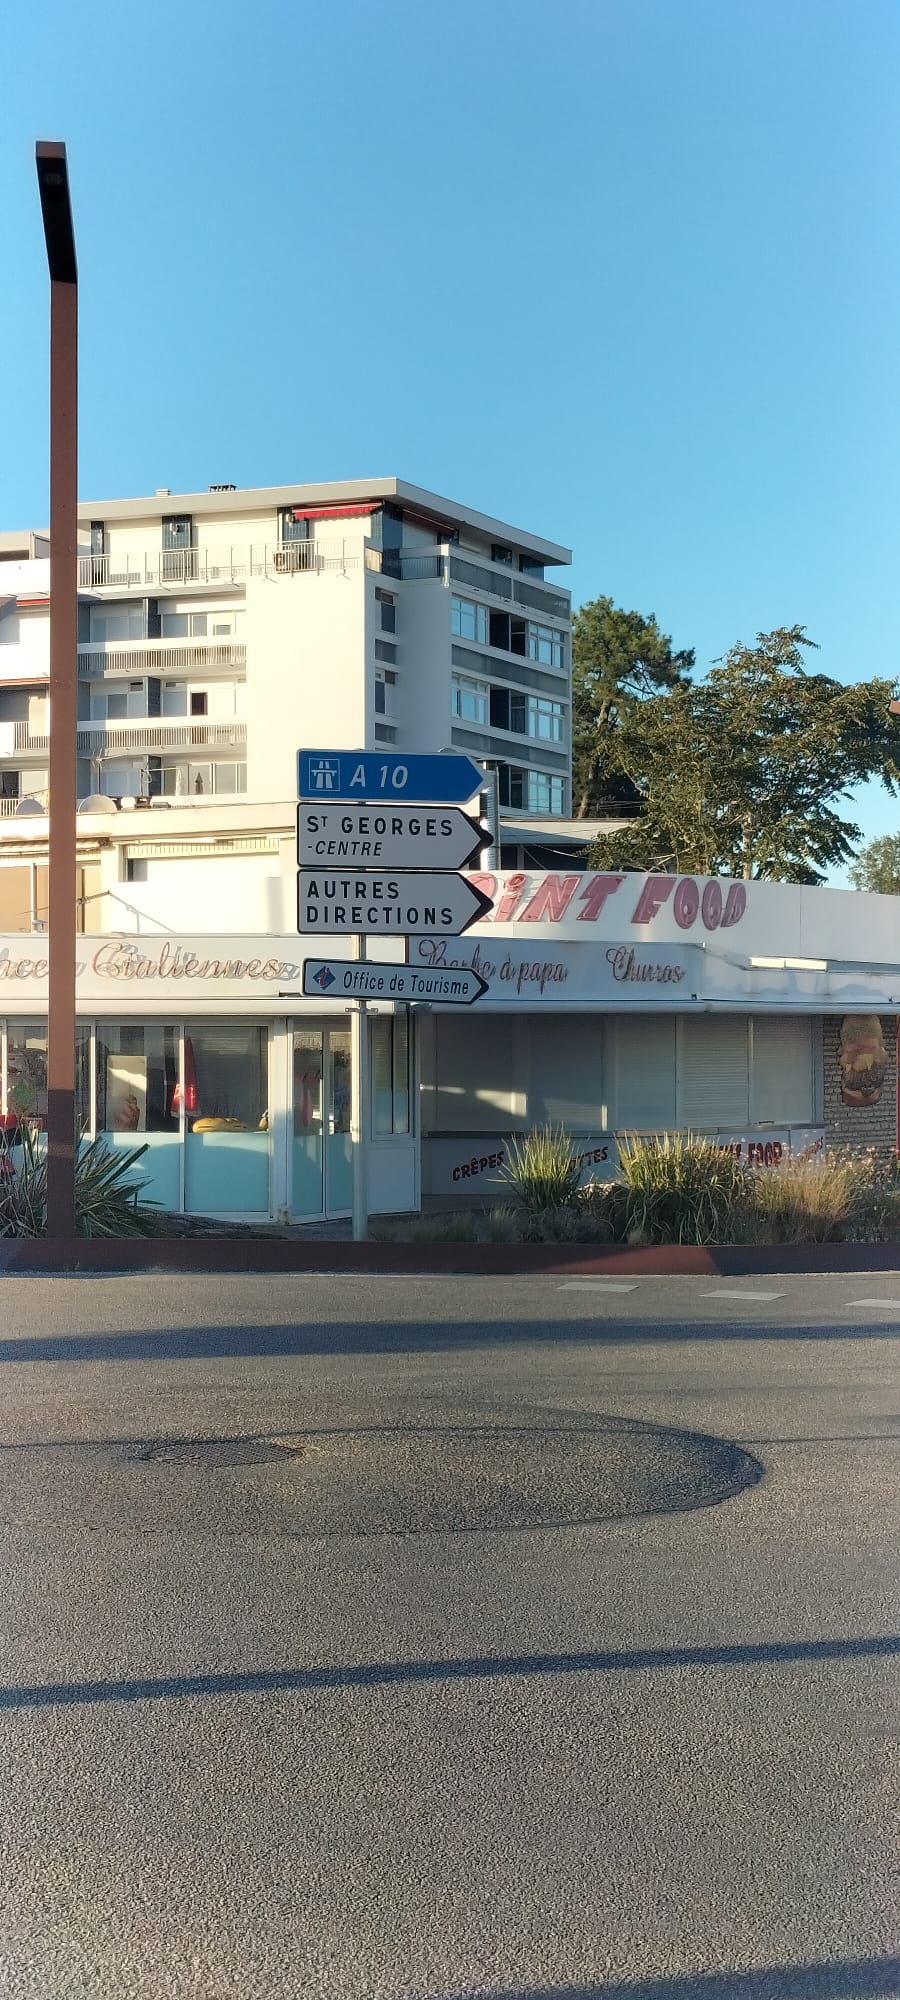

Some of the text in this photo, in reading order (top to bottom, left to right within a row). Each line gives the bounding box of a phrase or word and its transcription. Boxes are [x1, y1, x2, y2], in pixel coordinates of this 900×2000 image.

[350, 764, 408, 788] A 10
[341, 817, 453, 836] GEORGES
[307, 880, 400, 899] AUTRES
[306, 905, 454, 925] DIRECTIONS
[631, 876, 747, 931] FOOD
[605, 945, 685, 984] Churros
[343, 970, 469, 995] Office de Tourisme
[516, 961, 568, 995] papa
